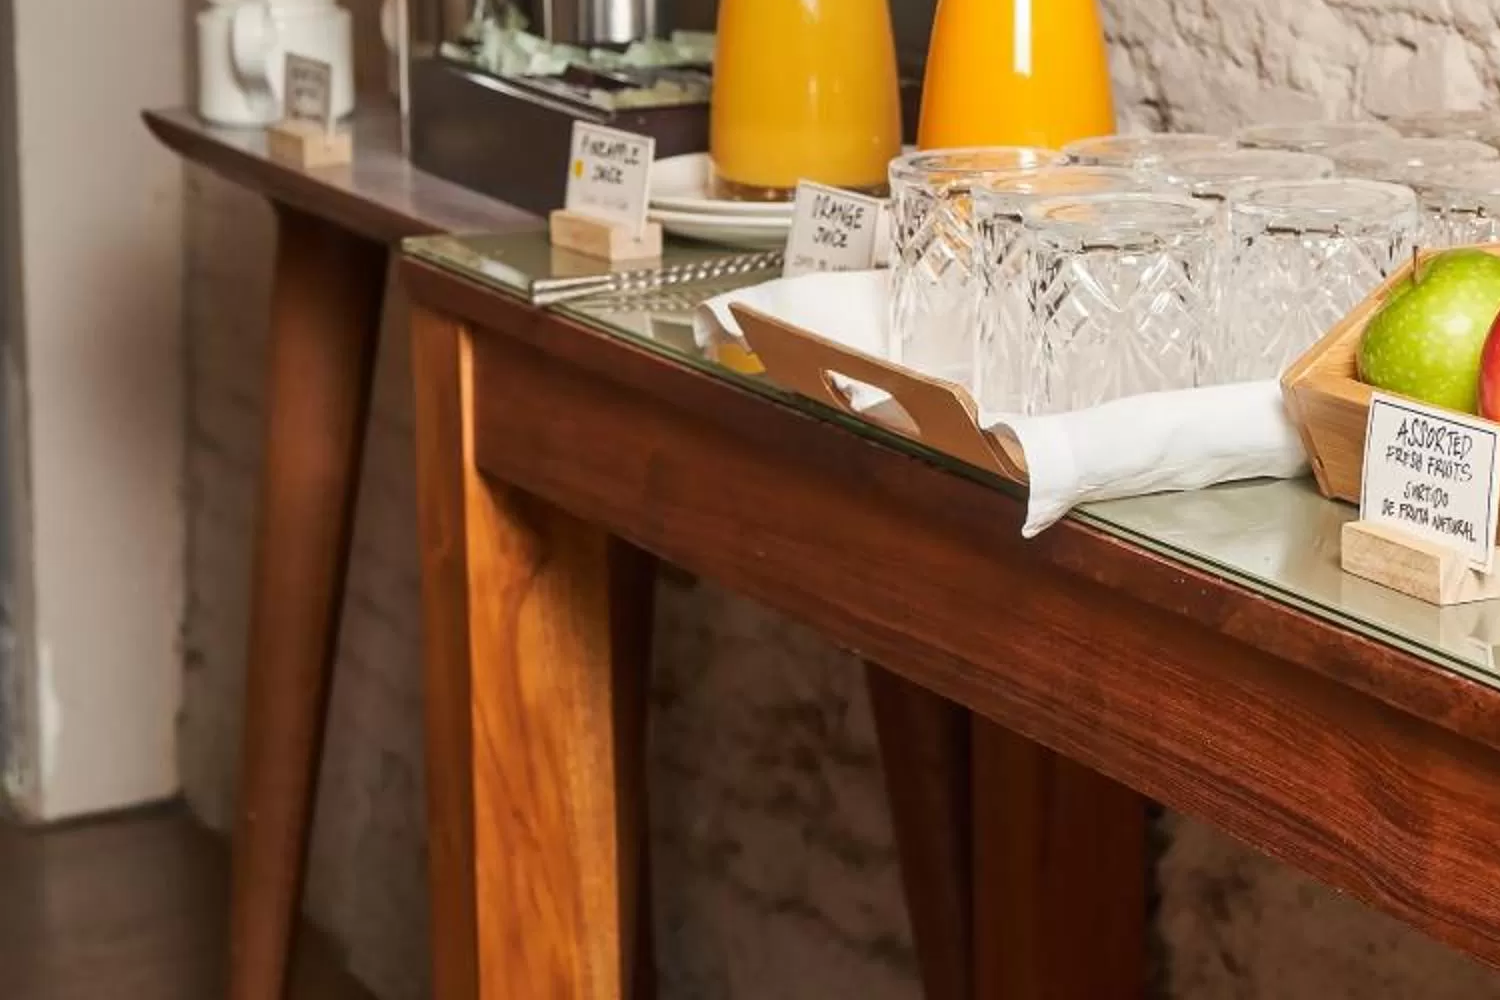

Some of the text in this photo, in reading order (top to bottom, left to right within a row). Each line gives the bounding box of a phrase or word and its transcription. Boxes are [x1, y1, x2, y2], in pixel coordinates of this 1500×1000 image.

[1395, 417, 1473, 460] ASSORTED
[1385, 445, 1474, 482] FRESH FRUITS
[1381, 497, 1477, 543] DE FRUTA NATURAL
